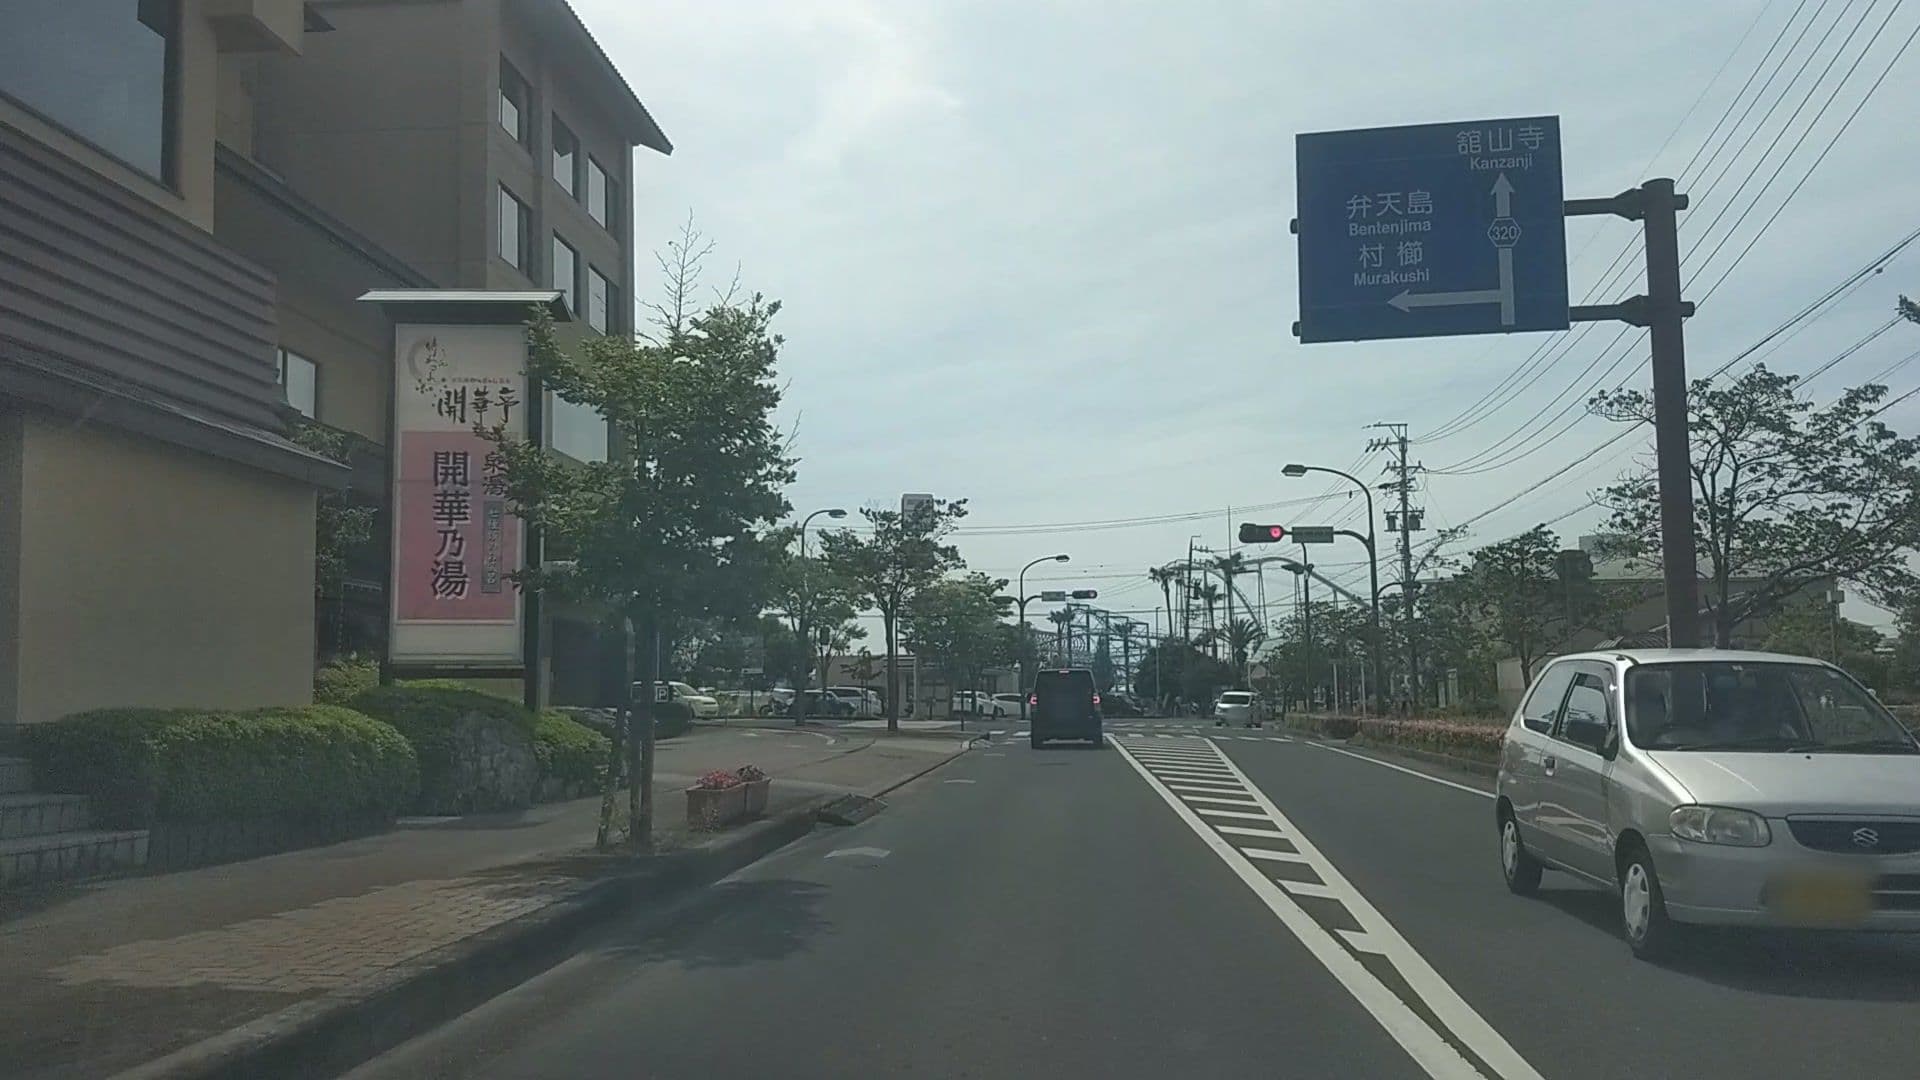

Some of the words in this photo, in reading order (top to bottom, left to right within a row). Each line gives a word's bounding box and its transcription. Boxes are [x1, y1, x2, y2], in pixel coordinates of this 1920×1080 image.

[1470, 153, 1533, 171] Kanzanji
[1345, 189, 1433, 219] 弁天島
[1348, 219, 1432, 237] Bentenjima
[1492, 225, 1517, 240] 320
[1353, 268, 1430, 287] Murakushi
[431, 451, 471, 599] 開華乃湯
